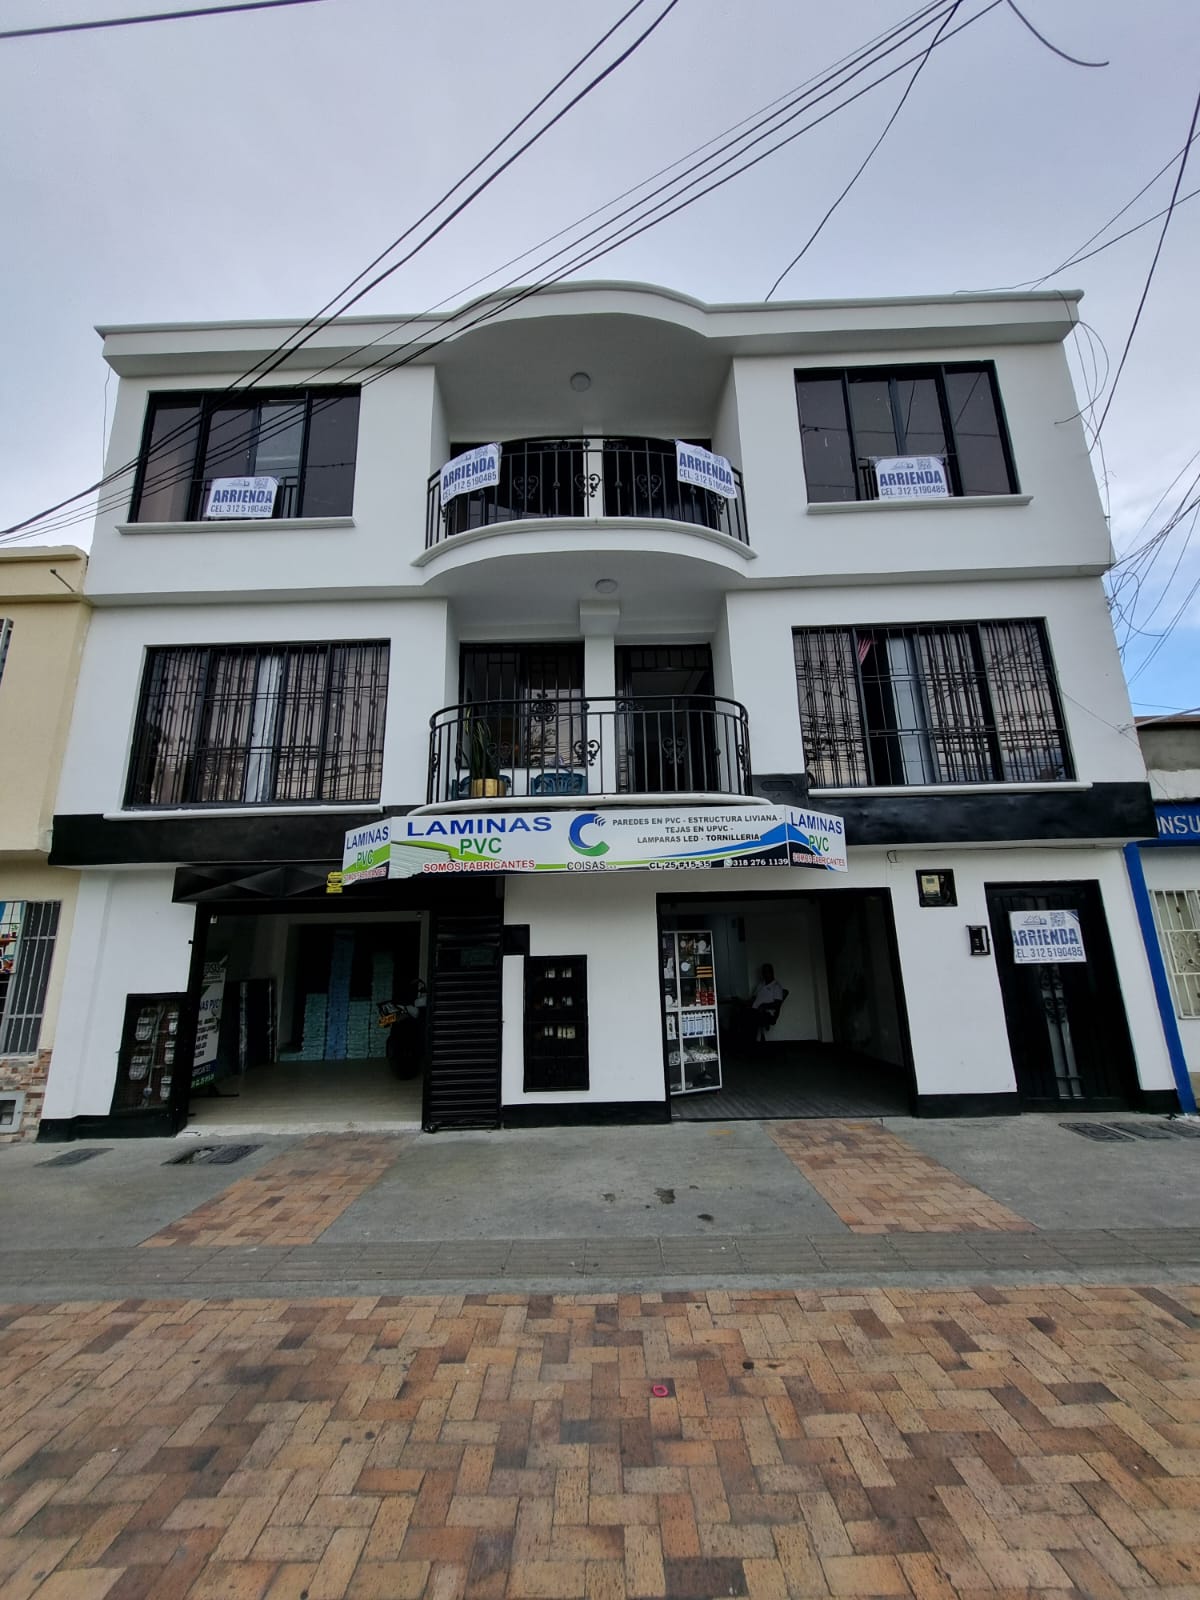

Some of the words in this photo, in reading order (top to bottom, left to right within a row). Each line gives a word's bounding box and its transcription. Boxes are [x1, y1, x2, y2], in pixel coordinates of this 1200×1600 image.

[443, 456, 495, 490] ARRIENDA
[680, 453, 732, 486] ARRIENDA
[880, 470, 943, 487] ARRIENDA
[212, 489, 273, 503] ARRIENDA
[407, 816, 552, 836] LAMINAS
[612, 818, 649, 826] PAREDES
[688, 815, 742, 824] ESTRUCTURA
[744, 814, 777, 822] LIVIANA
[790, 811, 842, 835] LAMINAS
[665, 825, 691, 833] TEJAS
[347, 826, 389, 850] LAMINAS
[460, 837, 502, 854] PVC
[637, 835, 681, 843] LAMPARAS
[683, 834, 699, 842] LED
[706, 833, 760, 842] TORNILLERIA
[808, 834, 830, 852] PVC
[356, 849, 374, 867] PVC
[424, 862, 461, 872] SOMOS
[463, 860, 535, 871] FABRICANTES
[567, 860, 606, 870] COISAS
[733, 859, 748, 867] 318
[768, 858, 789, 866] 1139
